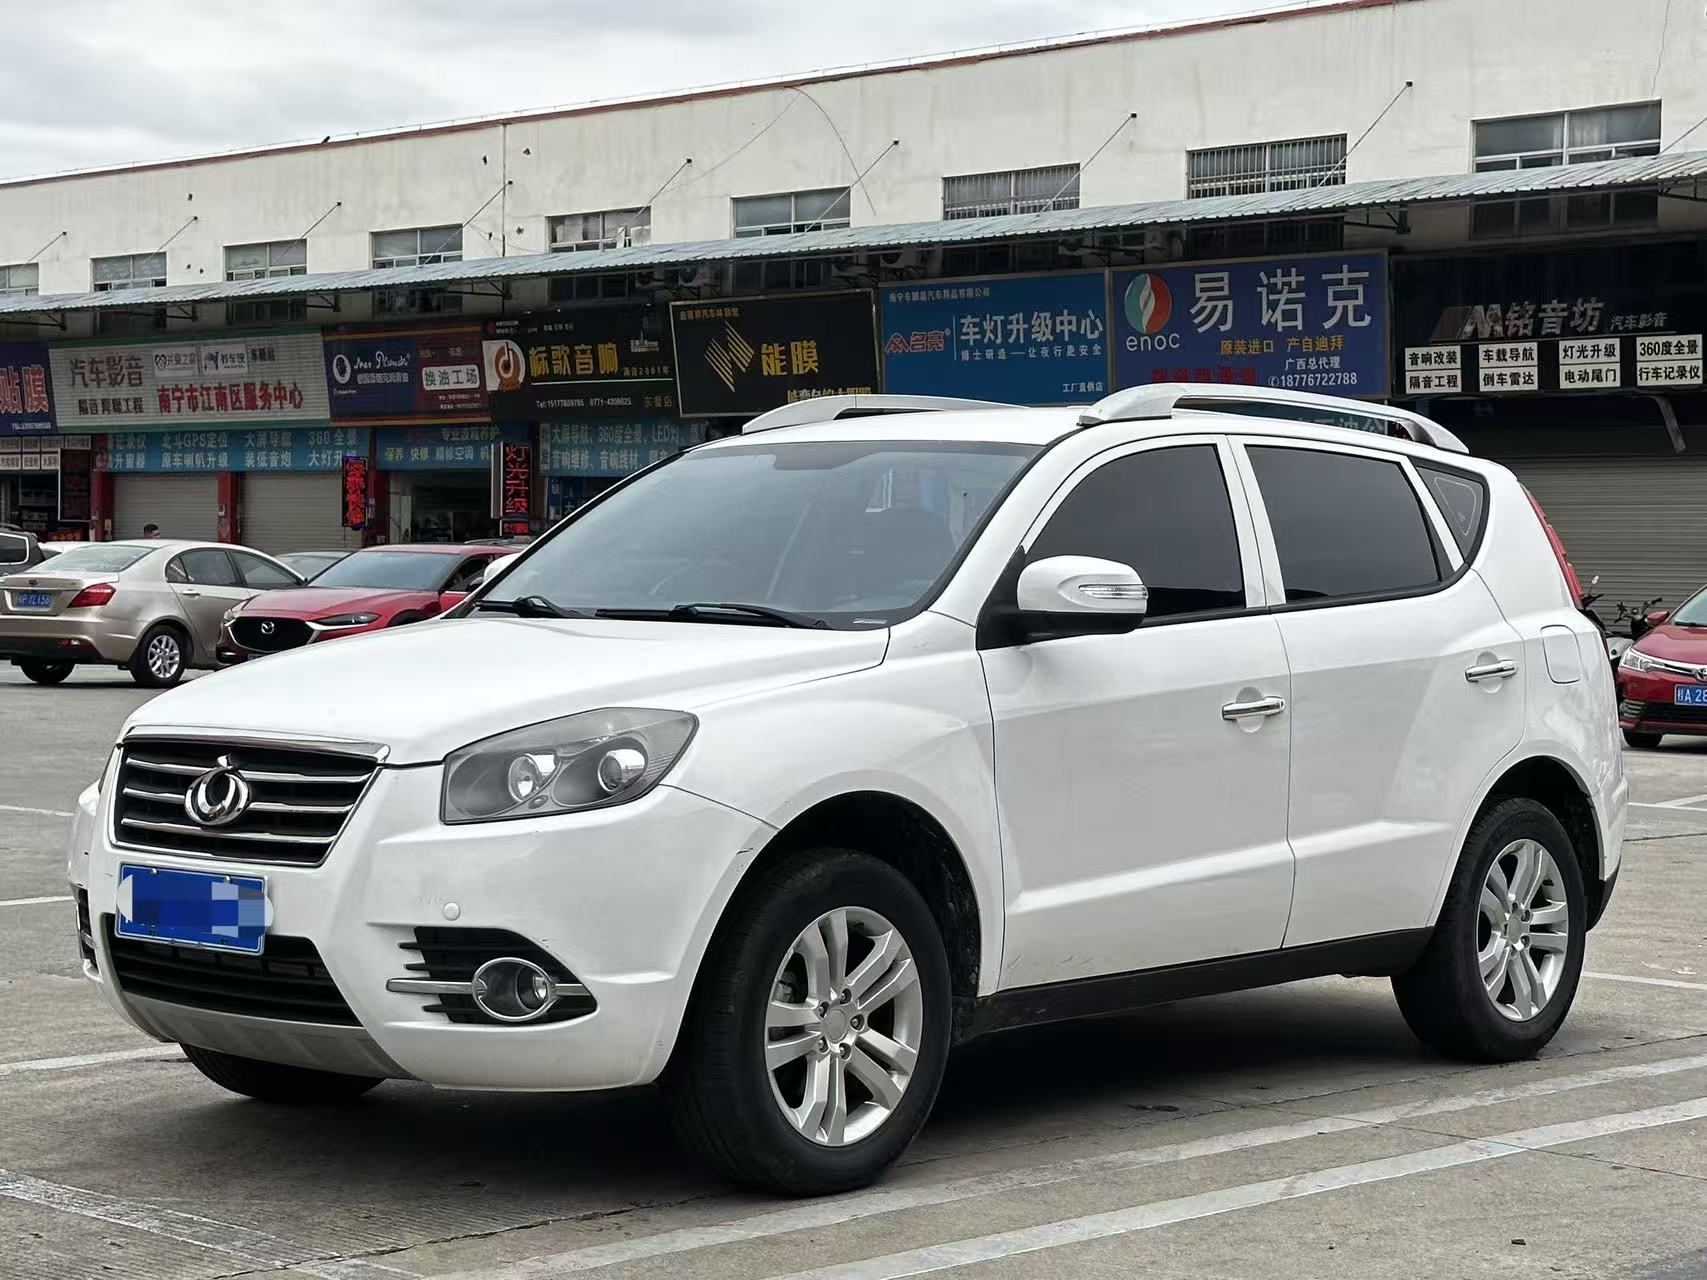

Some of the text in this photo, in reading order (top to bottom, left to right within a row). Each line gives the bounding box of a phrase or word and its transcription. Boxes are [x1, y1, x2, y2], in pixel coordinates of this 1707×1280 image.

[1189, 264, 1371, 333] 易诺克
[960, 308, 1103, 347] 车灯升级中心
[1610, 312, 1667, 331] 汽车影音
[1126, 333, 1180, 352] enoc
[1219, 335, 1344, 356] 原装进口 产自迪拜
[1563, 343, 1616, 359] 灯光升级
[1639, 340, 1699, 356] 360度全景
[528, 341, 619, 377] 标歌音响
[761, 340, 819, 376] 能膜
[1285, 356, 1341, 371] 广西总代理
[1409, 350, 1458, 366] 音响改装
[1482, 347, 1535, 363] 车载导航
[70, 355, 144, 388] 汽车影音
[425, 367, 477, 387] 换油工场
[1280, 373, 1357, 388] 18776722788
[1482, 371, 1535, 387] 倒车雷达
[1564, 368, 1617, 384] 电动尾门
[1638, 365, 1701, 382] 行车记录仪
[1409, 374, 1459, 390] 隔音工程
[157, 380, 303, 414] 南宁市江南区服务中心
[505, 446, 529, 513] 灯光升级
